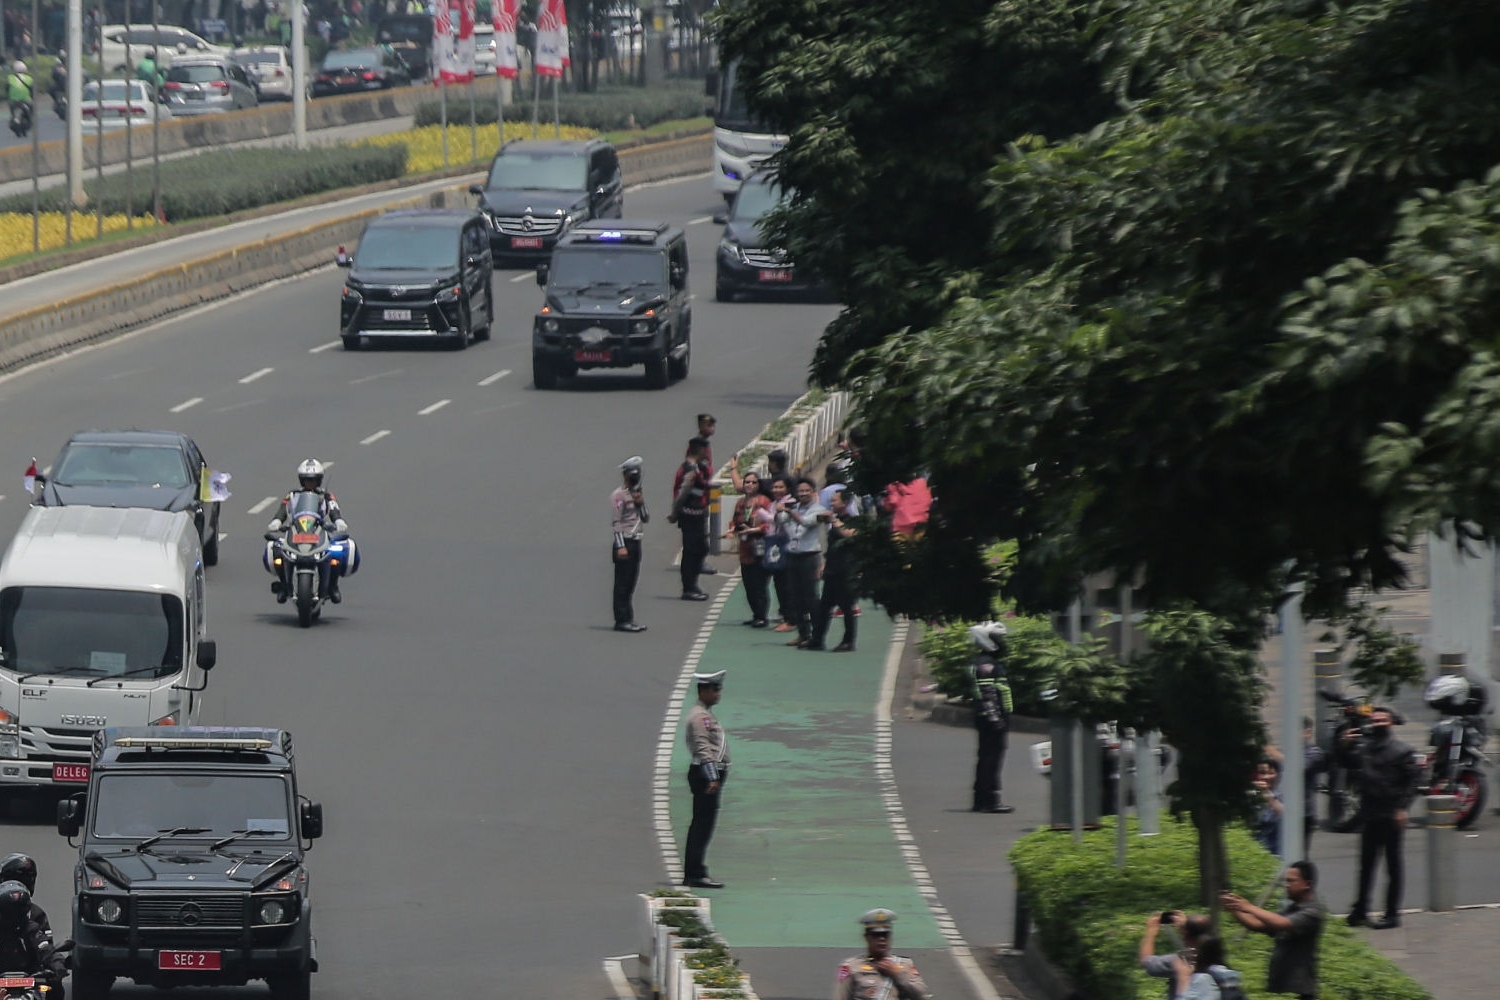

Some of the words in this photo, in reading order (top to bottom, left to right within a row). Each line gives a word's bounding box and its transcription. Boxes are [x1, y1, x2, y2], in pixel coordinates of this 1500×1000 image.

[23, 688, 48, 697] ELF
[61, 714, 107, 726] ISUZU
[56, 766, 87, 777] DELEG
[174, 954, 194, 966] SEC
[198, 954, 205, 966] 2
